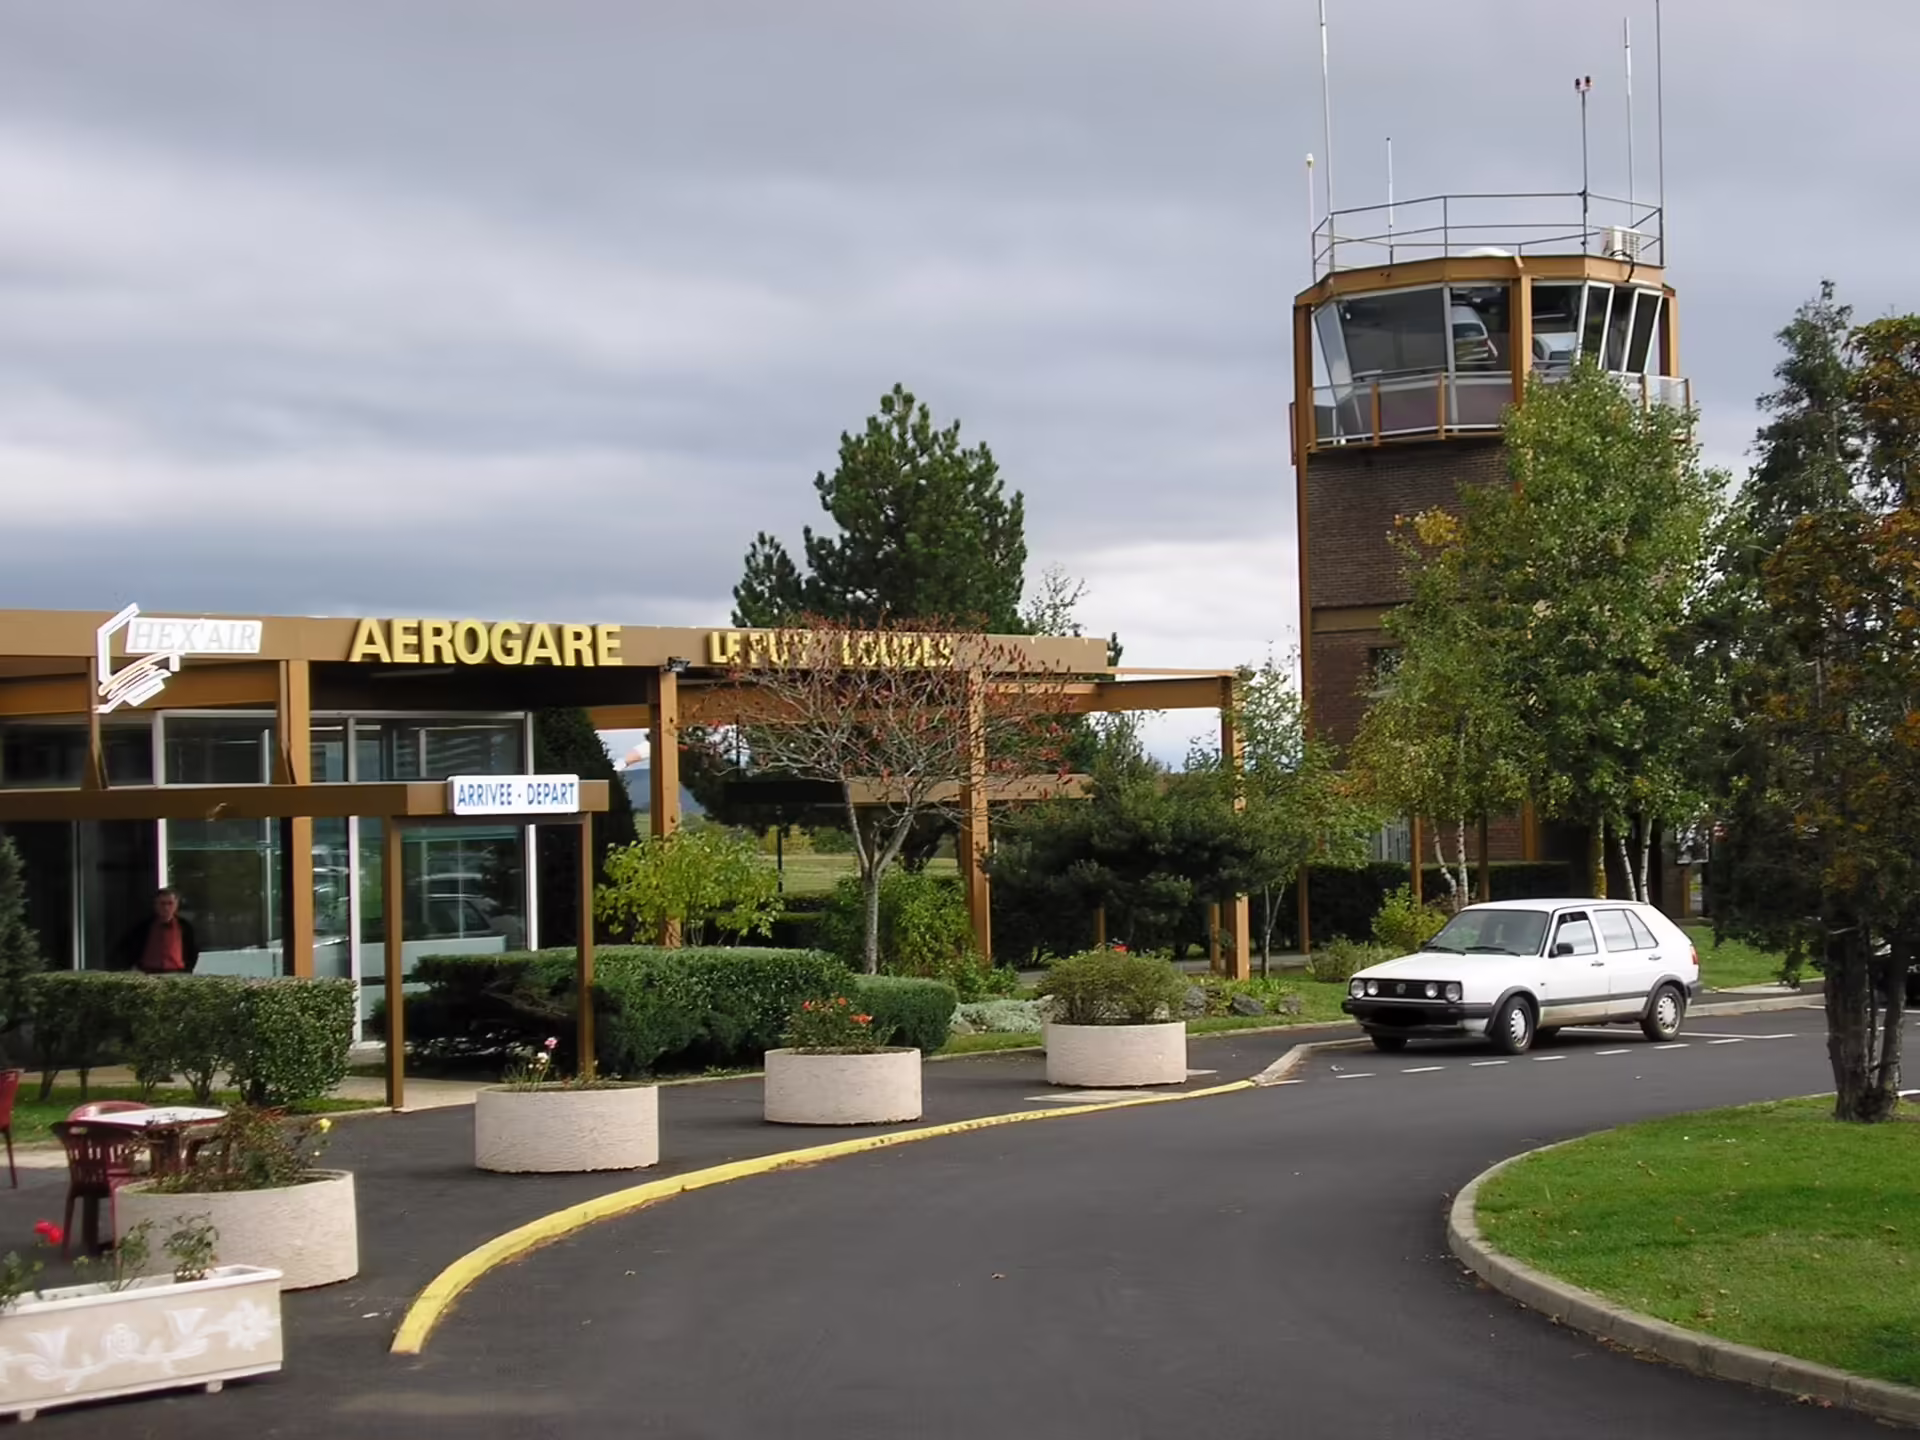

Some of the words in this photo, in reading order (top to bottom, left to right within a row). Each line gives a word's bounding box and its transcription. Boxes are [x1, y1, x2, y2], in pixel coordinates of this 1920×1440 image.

[349, 617, 623, 667] AEROGARE
[710, 631, 741, 664] LE
[456, 782, 513, 807] ARRIVEE
[526, 782, 575, 806] DEPART
